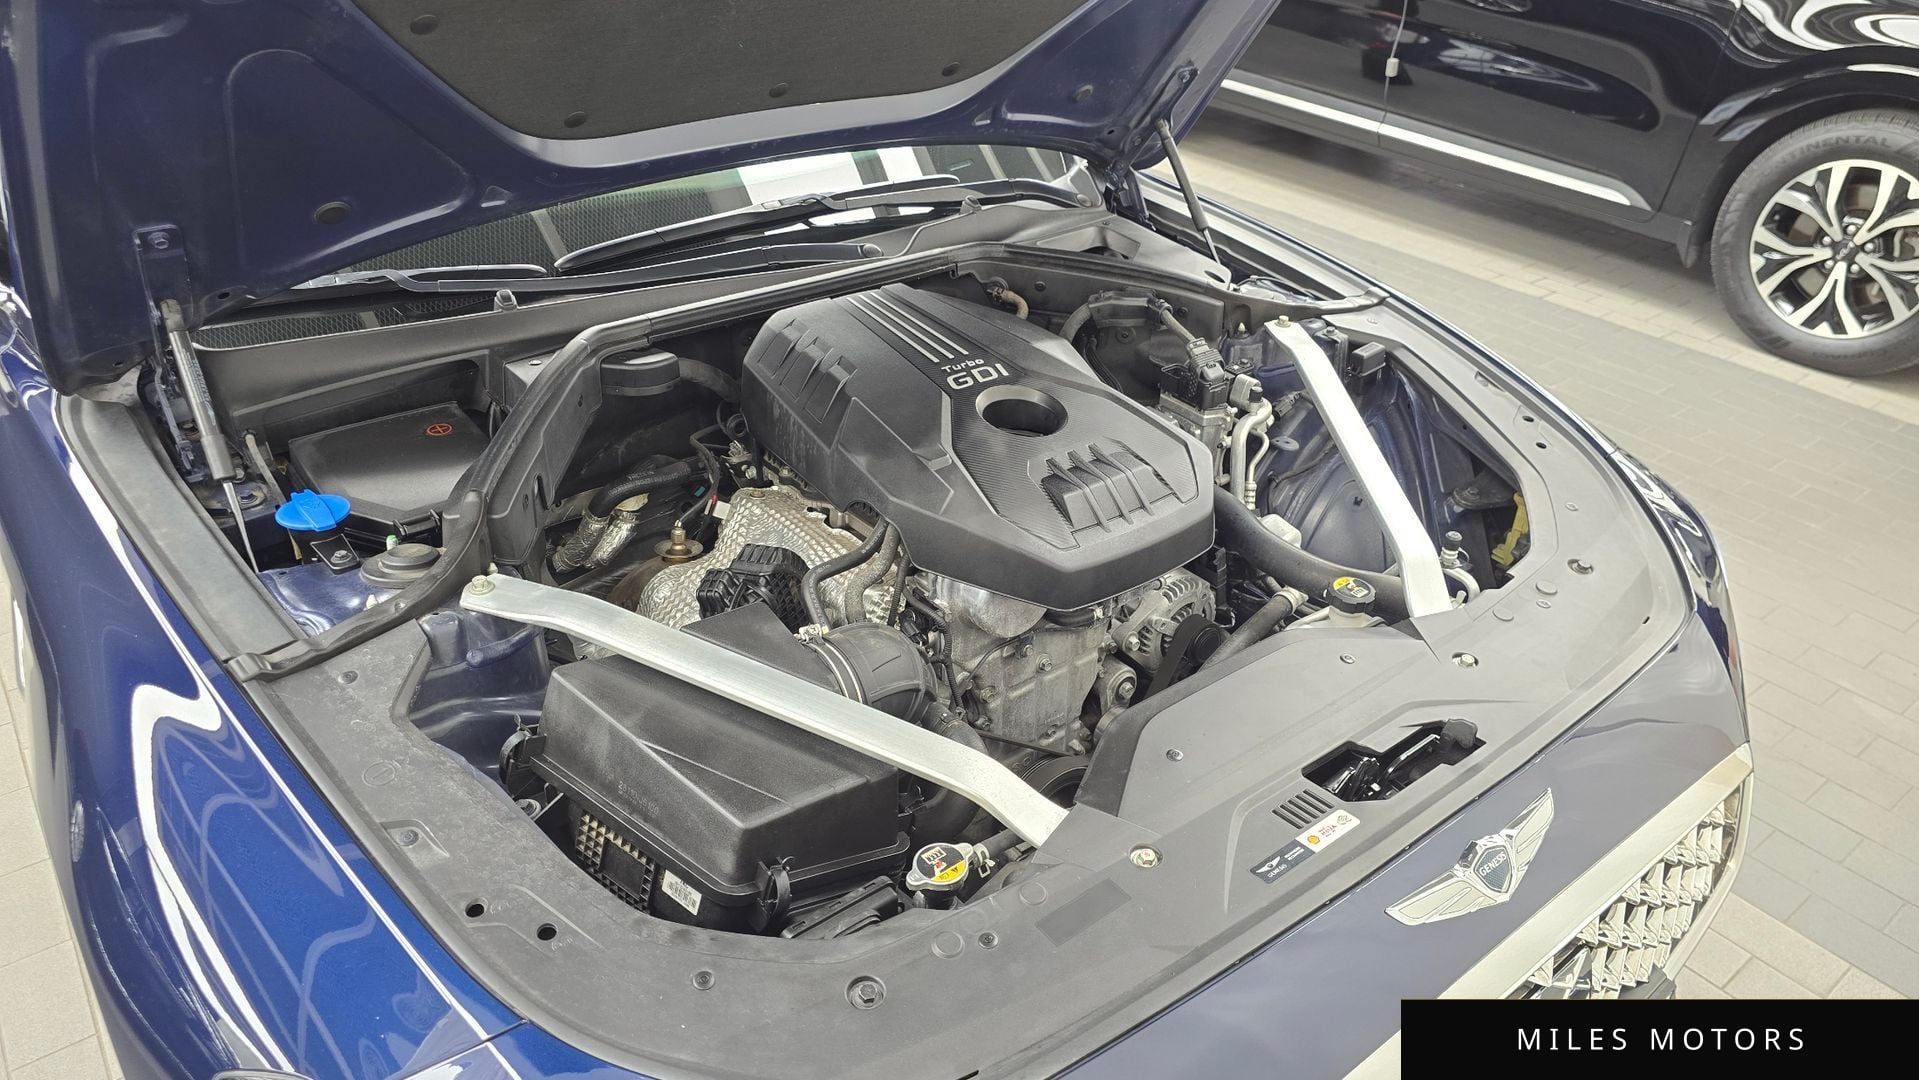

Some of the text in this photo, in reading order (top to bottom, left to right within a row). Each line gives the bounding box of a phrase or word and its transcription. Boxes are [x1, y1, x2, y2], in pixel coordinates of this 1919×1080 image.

[941, 359, 985, 373] Turbo
[947, 363, 1009, 390] GDI
[1479, 851, 1507, 877] GENESIS
